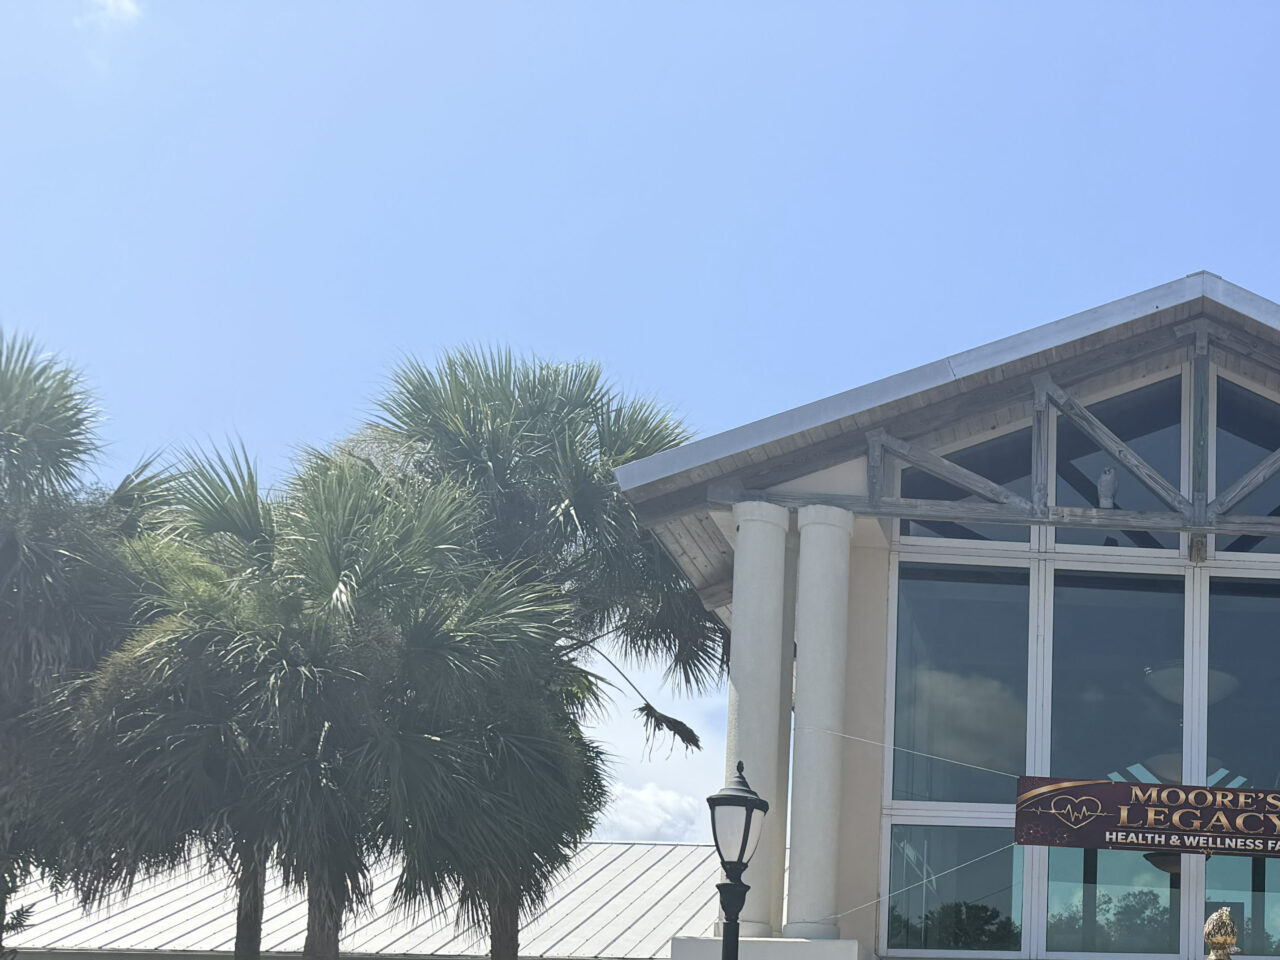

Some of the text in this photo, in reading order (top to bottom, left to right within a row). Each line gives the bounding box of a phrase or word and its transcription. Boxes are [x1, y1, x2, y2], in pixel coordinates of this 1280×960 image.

[1105, 831, 1167, 846] HEALTH
[1169, 834, 1181, 846] &
[1183, 834, 1265, 851] WELLNESS
